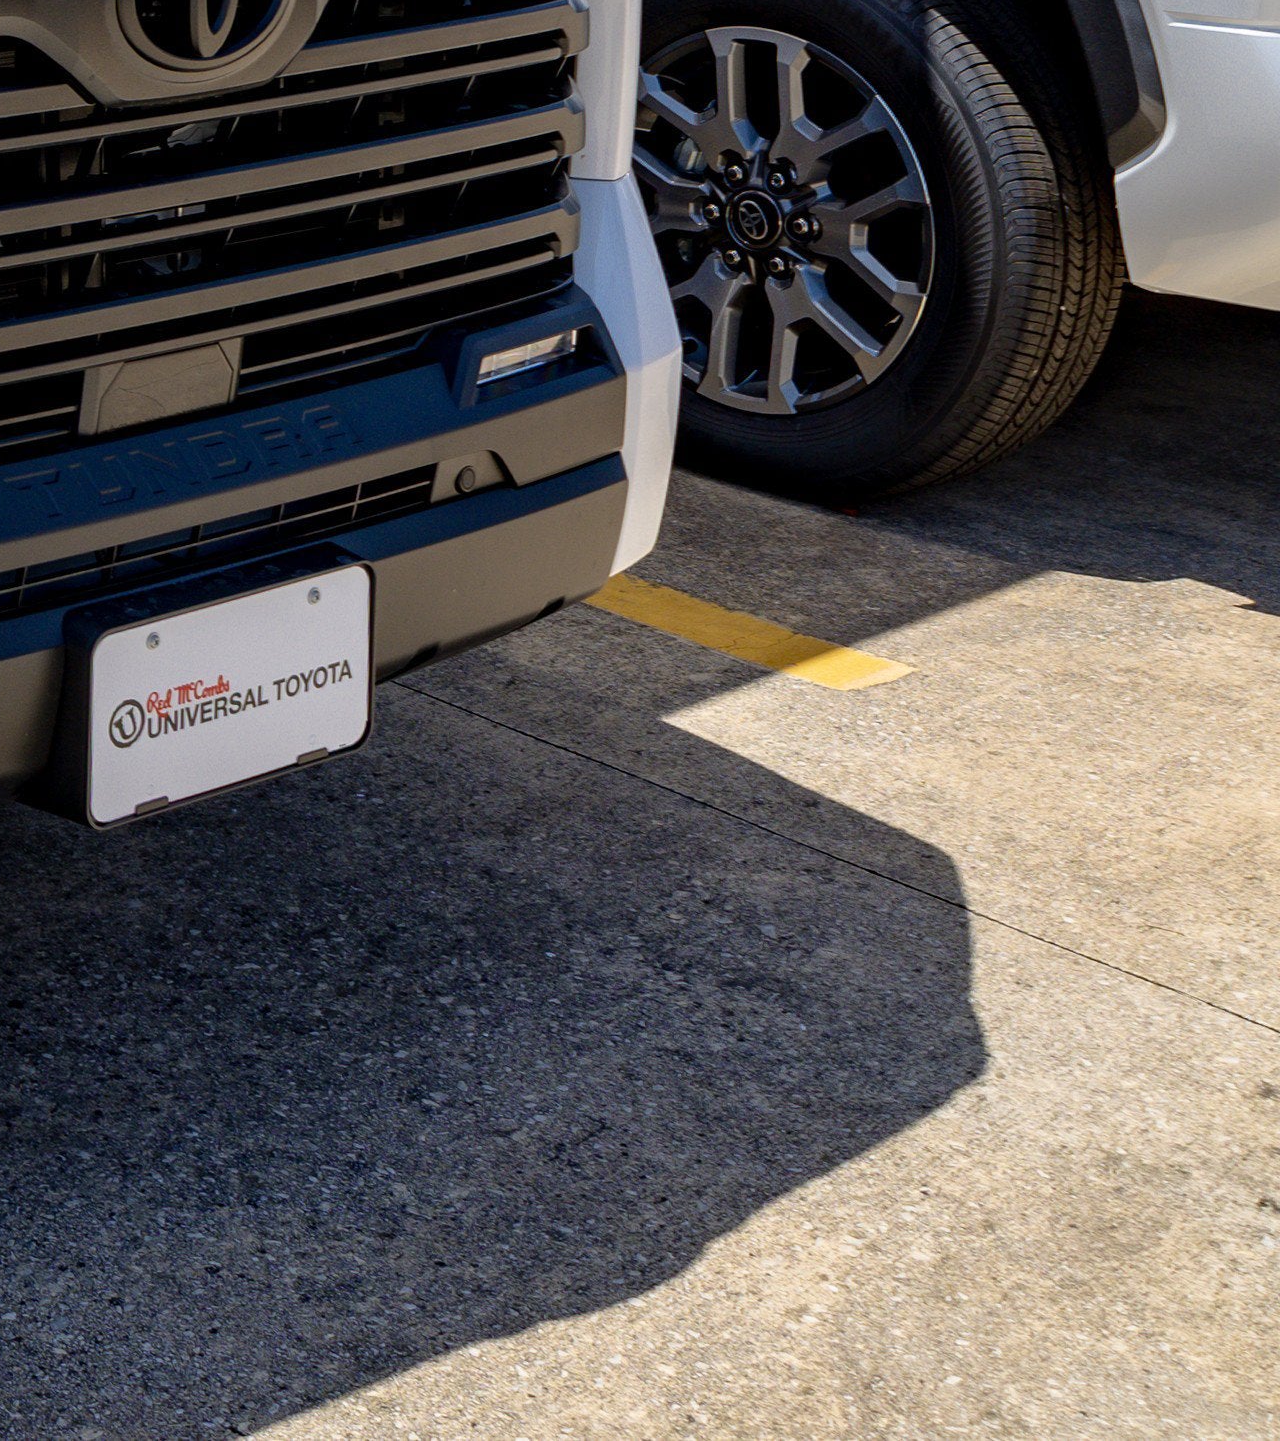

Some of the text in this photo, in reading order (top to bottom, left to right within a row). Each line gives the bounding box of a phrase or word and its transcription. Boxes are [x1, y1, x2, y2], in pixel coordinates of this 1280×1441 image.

[3, 405, 366, 518] TUNDRA
[146, 674, 230, 718] Red McCombs
[147, 659, 353, 739] UNIVERSAL TOYOTA
